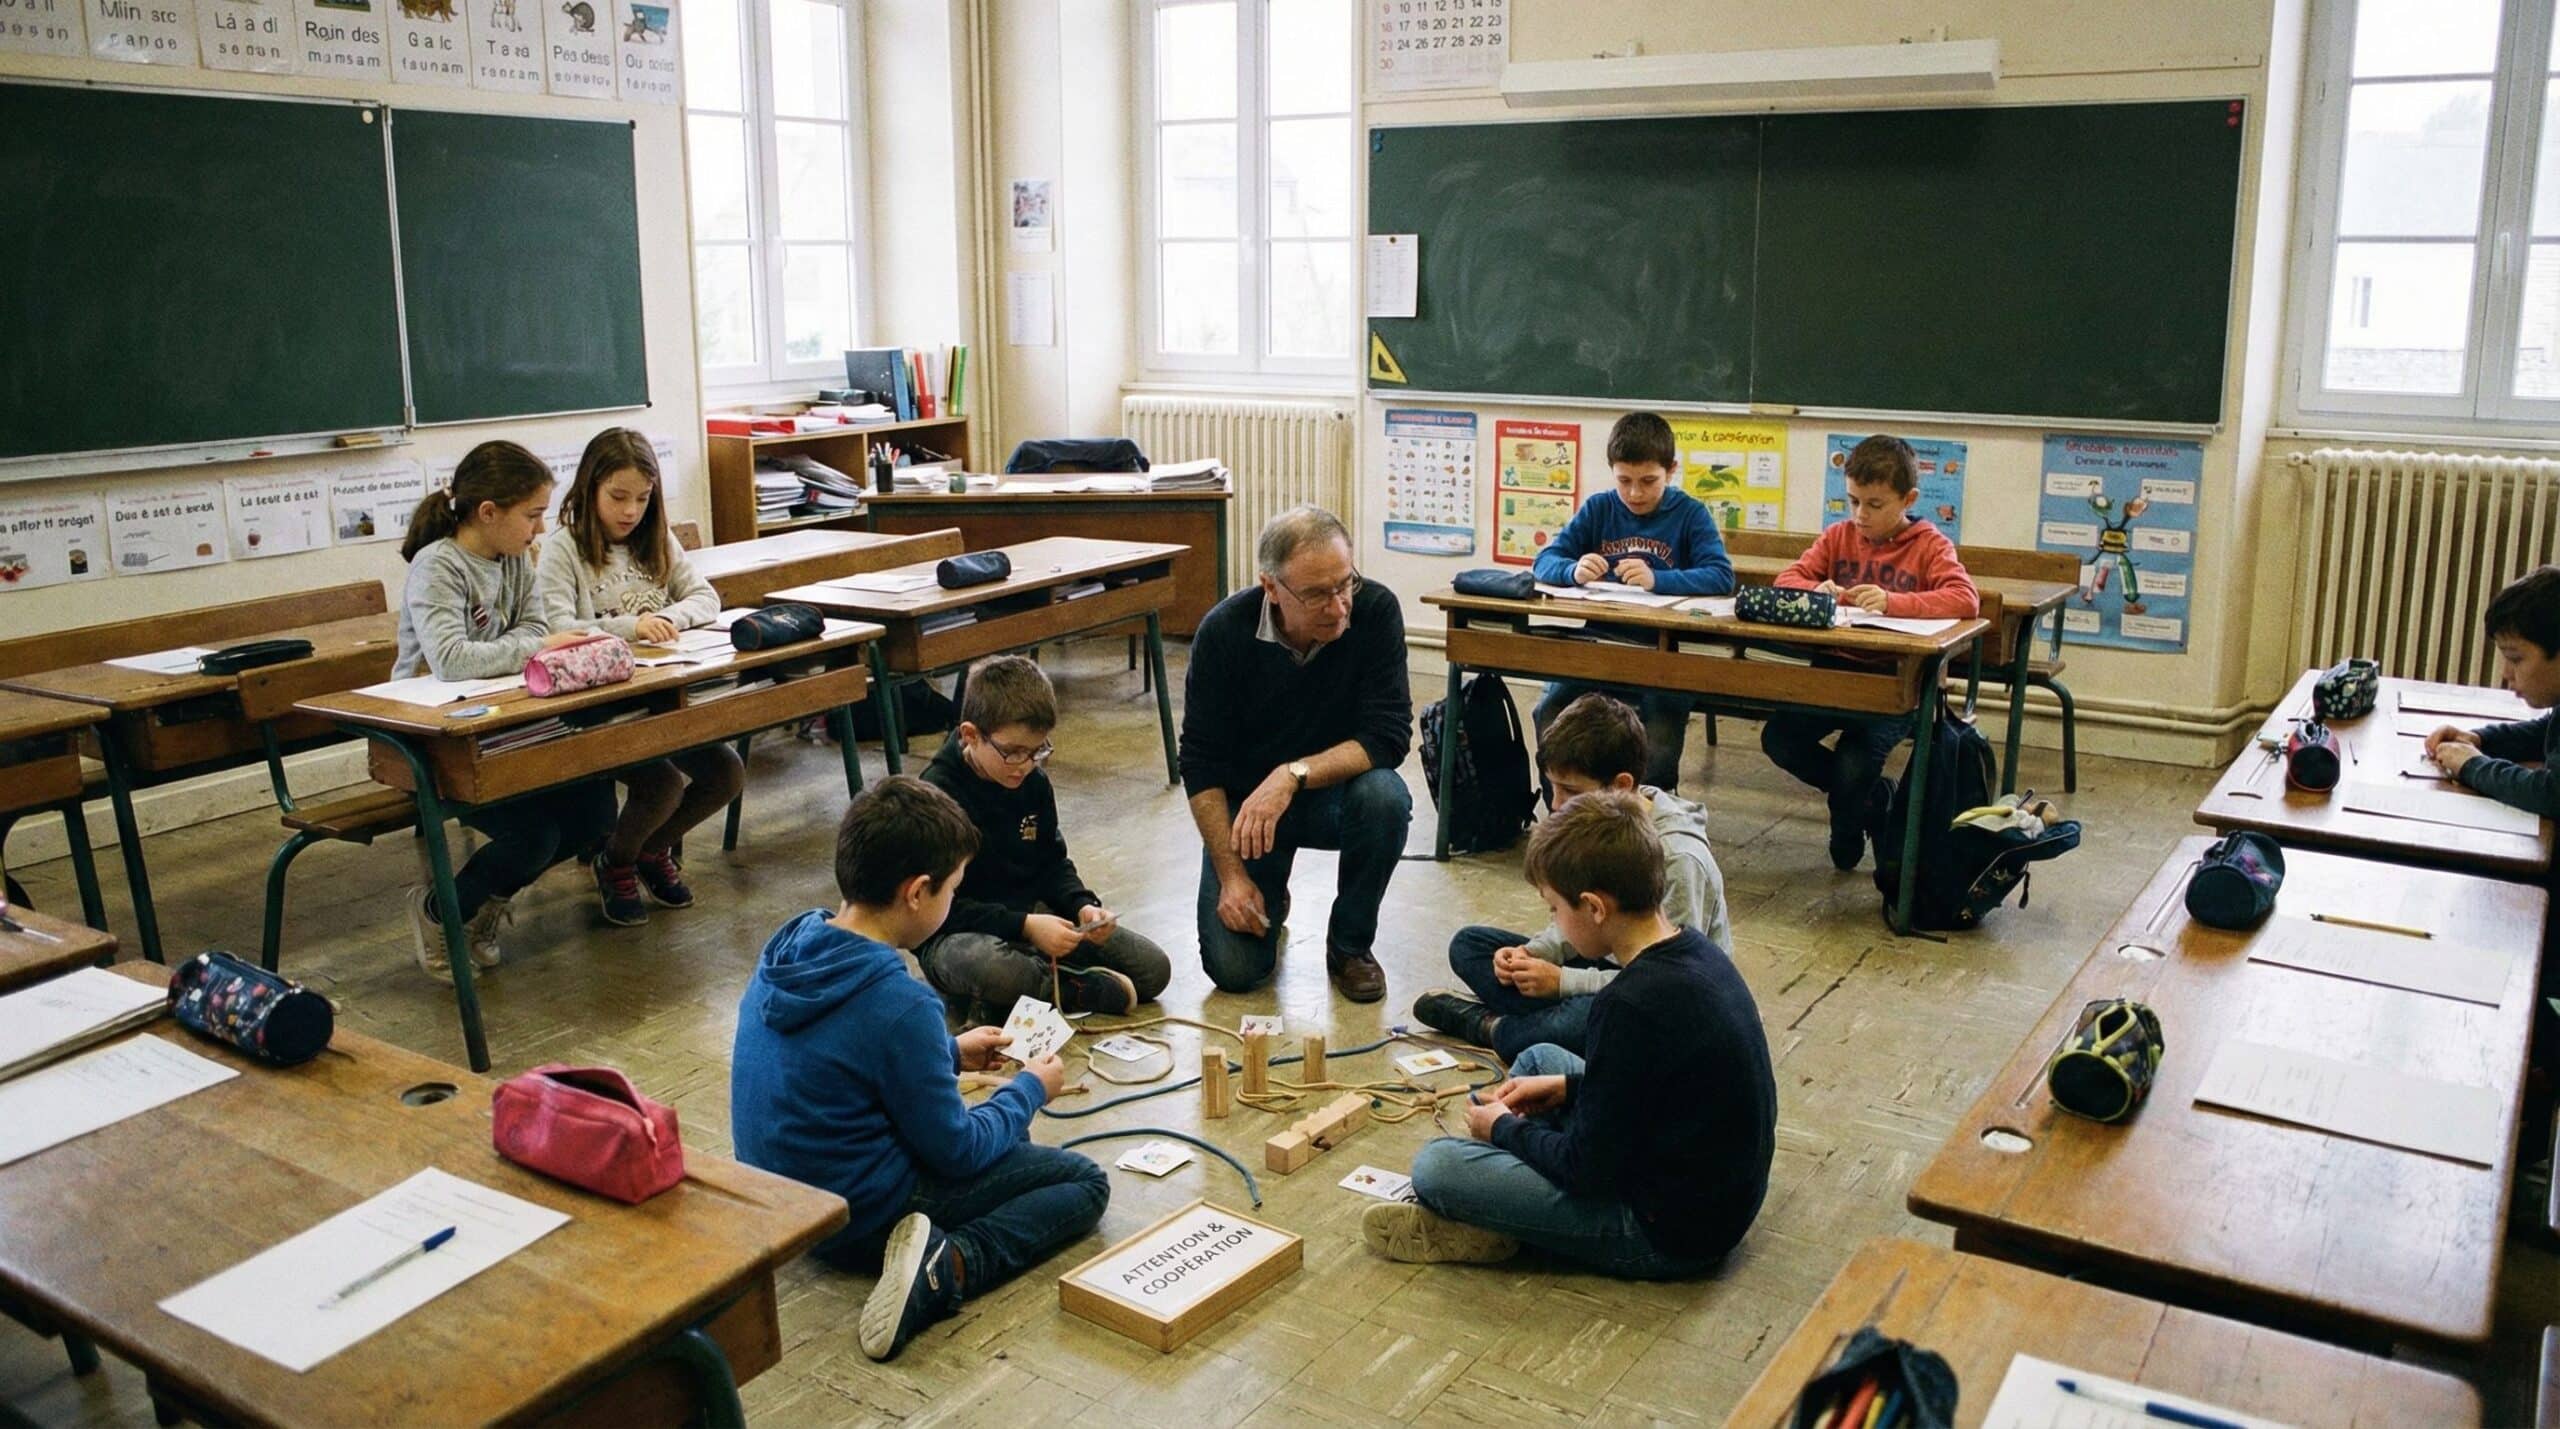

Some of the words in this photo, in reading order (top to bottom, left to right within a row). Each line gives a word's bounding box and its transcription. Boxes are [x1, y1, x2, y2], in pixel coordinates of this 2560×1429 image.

[1400, 1, 1411, 13] 10
[1417, 1, 1428, 12] 11
[1435, 0, 1447, 11] 12
[1400, 20, 1410, 31] 17
[1417, 20, 1428, 31] 18
[1433, 19, 1447, 30] 20
[1452, 18, 1464, 29] 21
[1470, 16, 1484, 28] 22
[1488, 15, 1501, 26] 23
[352, 26, 379, 44] des
[1397, 40, 1410, 51] 24
[1433, 37, 1446, 48] 27
[1452, 36, 1465, 47] 28
[1470, 34, 1484, 46] 29
[1488, 33, 1501, 45] 29
[1122, 1230, 1210, 1284] ATTENTION
[1207, 1222, 1225, 1233] &
[1142, 1227, 1253, 1295] COOPÉRATION
